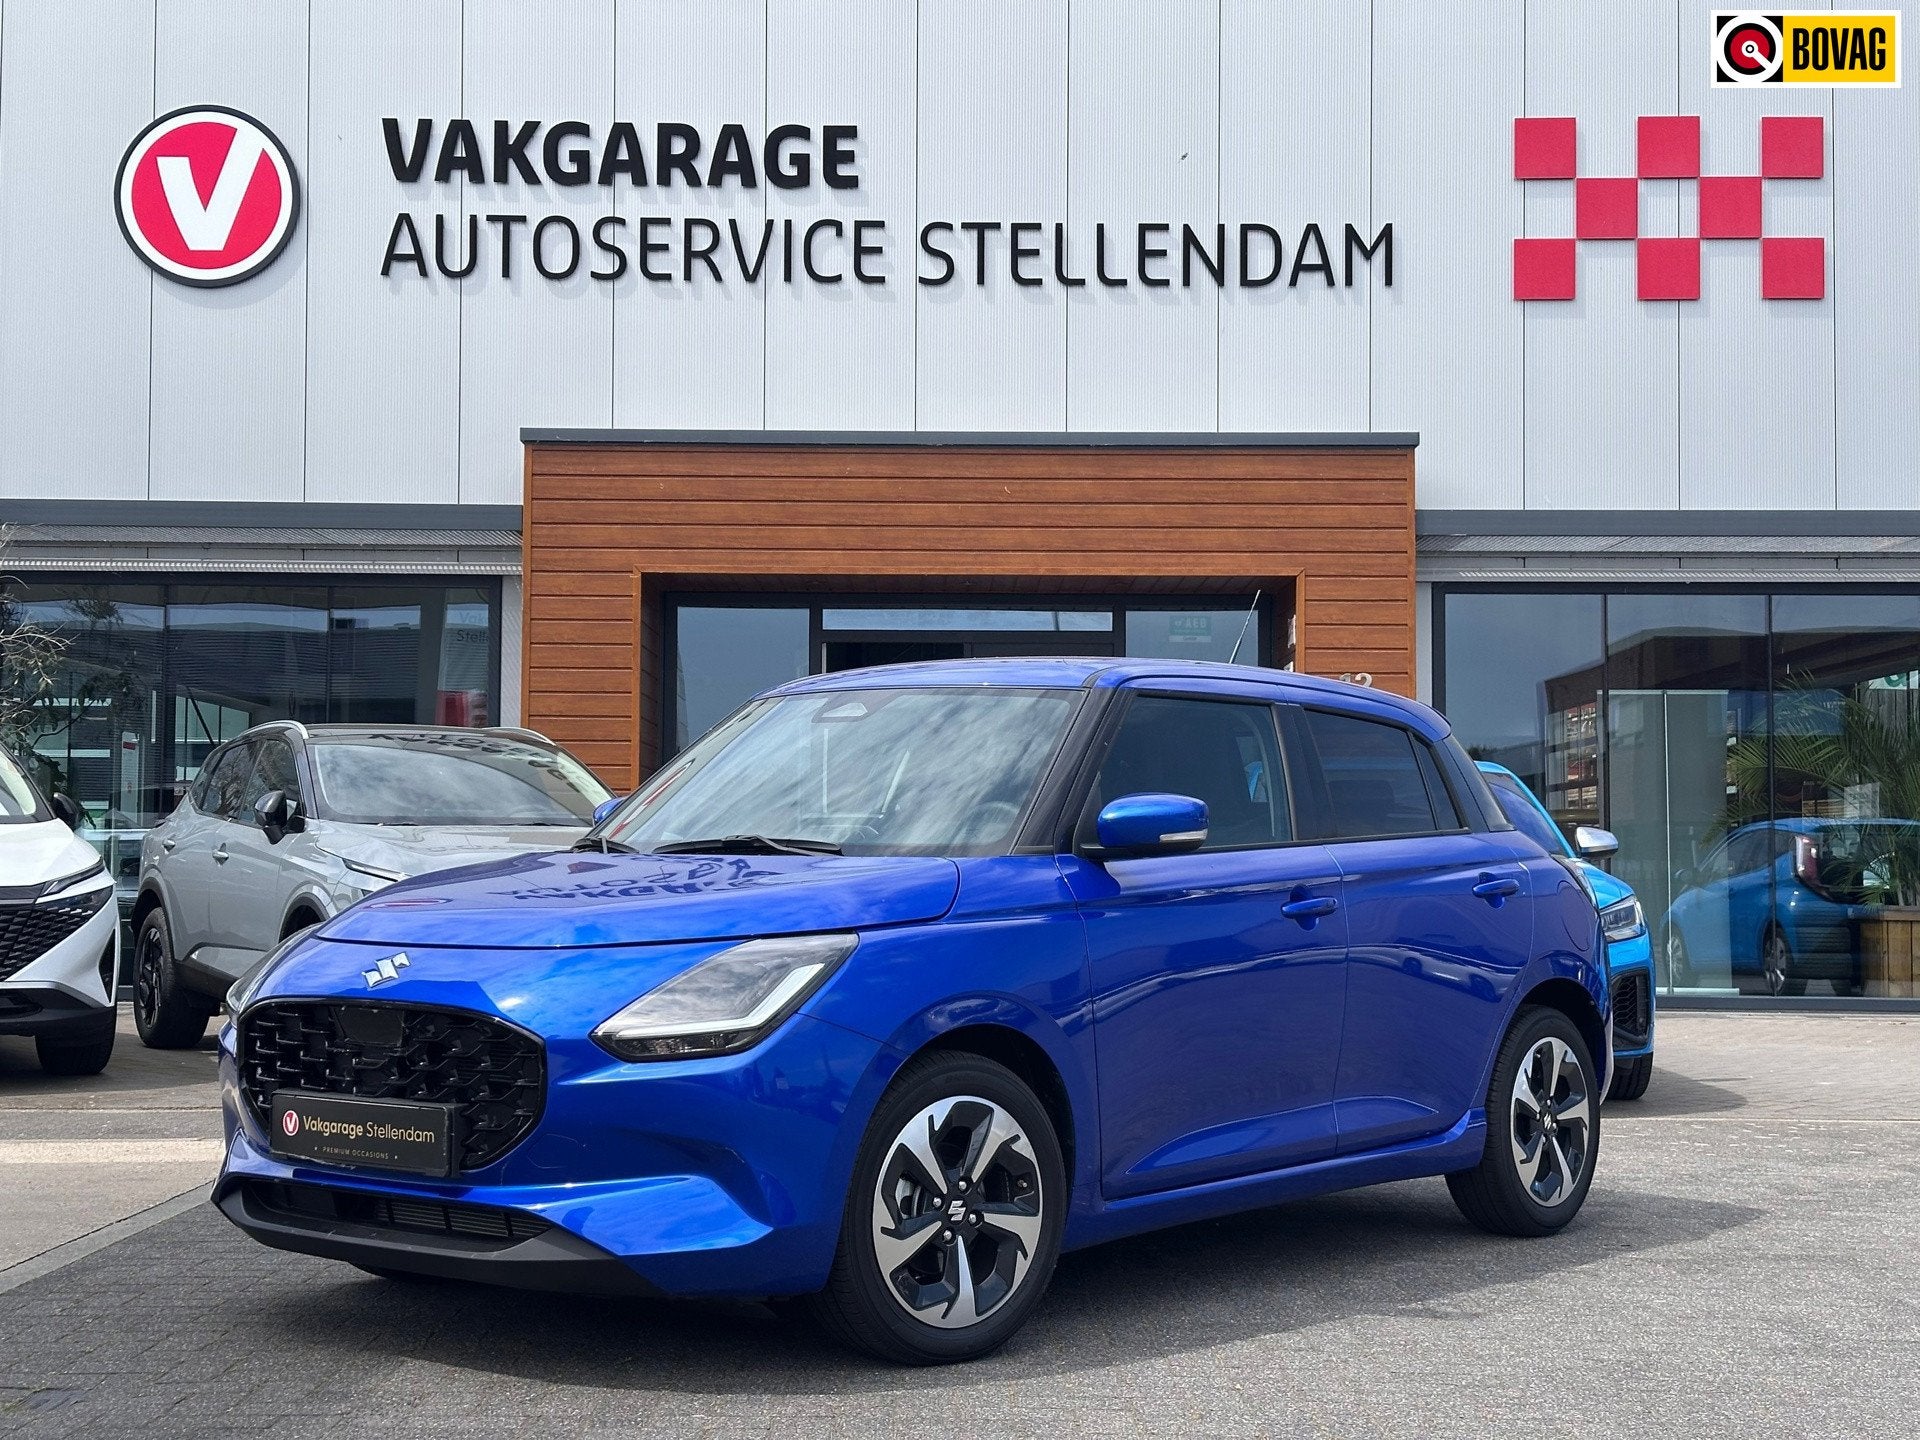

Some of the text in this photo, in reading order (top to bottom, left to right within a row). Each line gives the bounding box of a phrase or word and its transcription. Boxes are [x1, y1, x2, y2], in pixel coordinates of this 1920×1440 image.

[157, 126, 265, 251] V
[382, 118, 859, 189] VAKGARAGE
[380, 213, 1393, 287] AUTOSERVICE STELLENDAM
[303, 1115, 435, 1143] Vakgarage Stellendam
[322, 1146, 389, 1160] PREMIUM OCCASIONS
